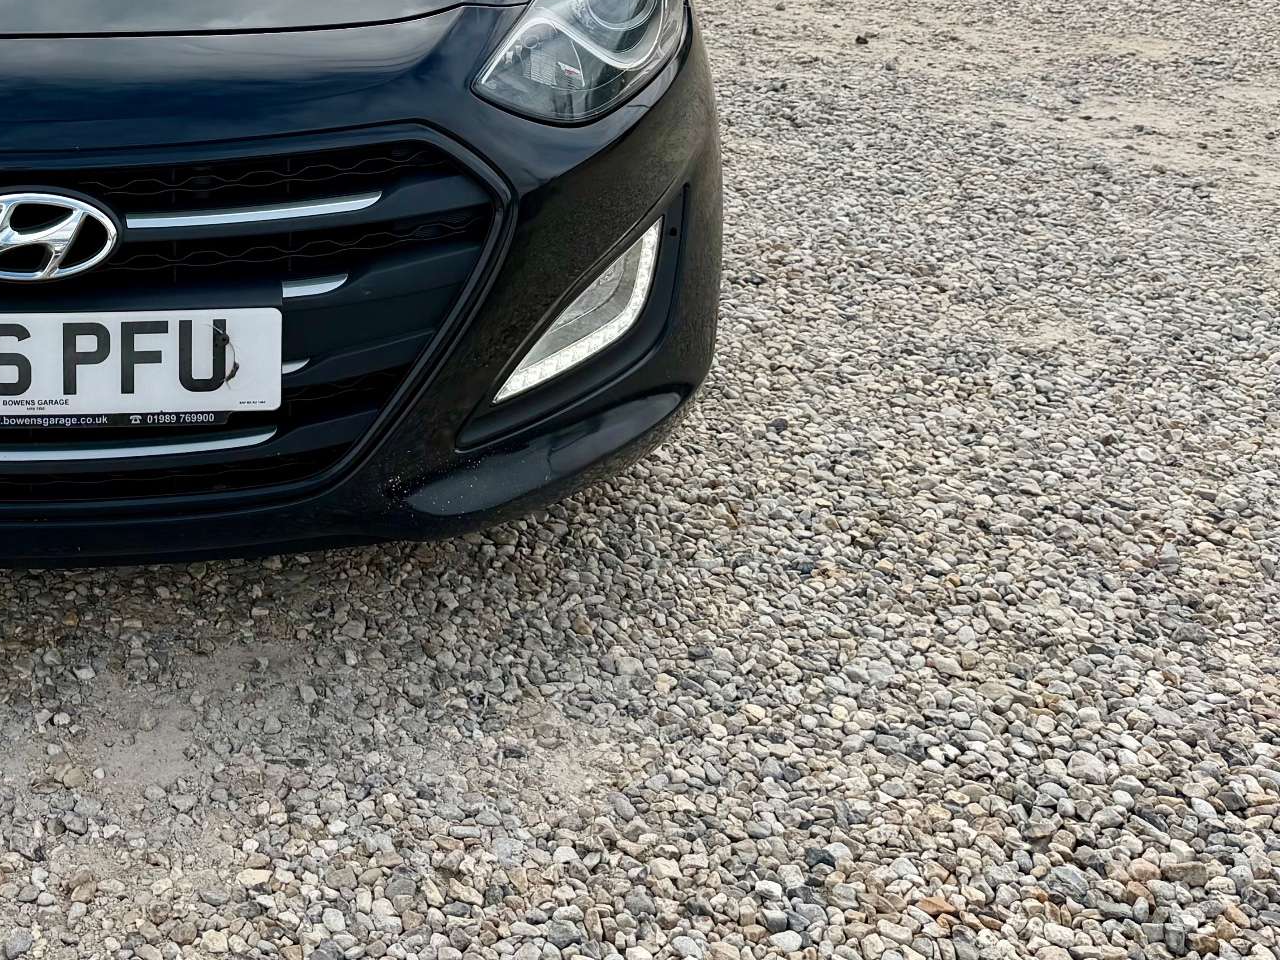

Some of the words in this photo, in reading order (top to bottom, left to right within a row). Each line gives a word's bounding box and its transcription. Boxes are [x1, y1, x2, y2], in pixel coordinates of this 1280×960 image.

[62, 318, 230, 395] PFU
[2, 399, 36, 407] BOWENS
[37, 398, 70, 406] GARAGE
[147, 414, 177, 424] 01989
[179, 413, 215, 424] 769900
